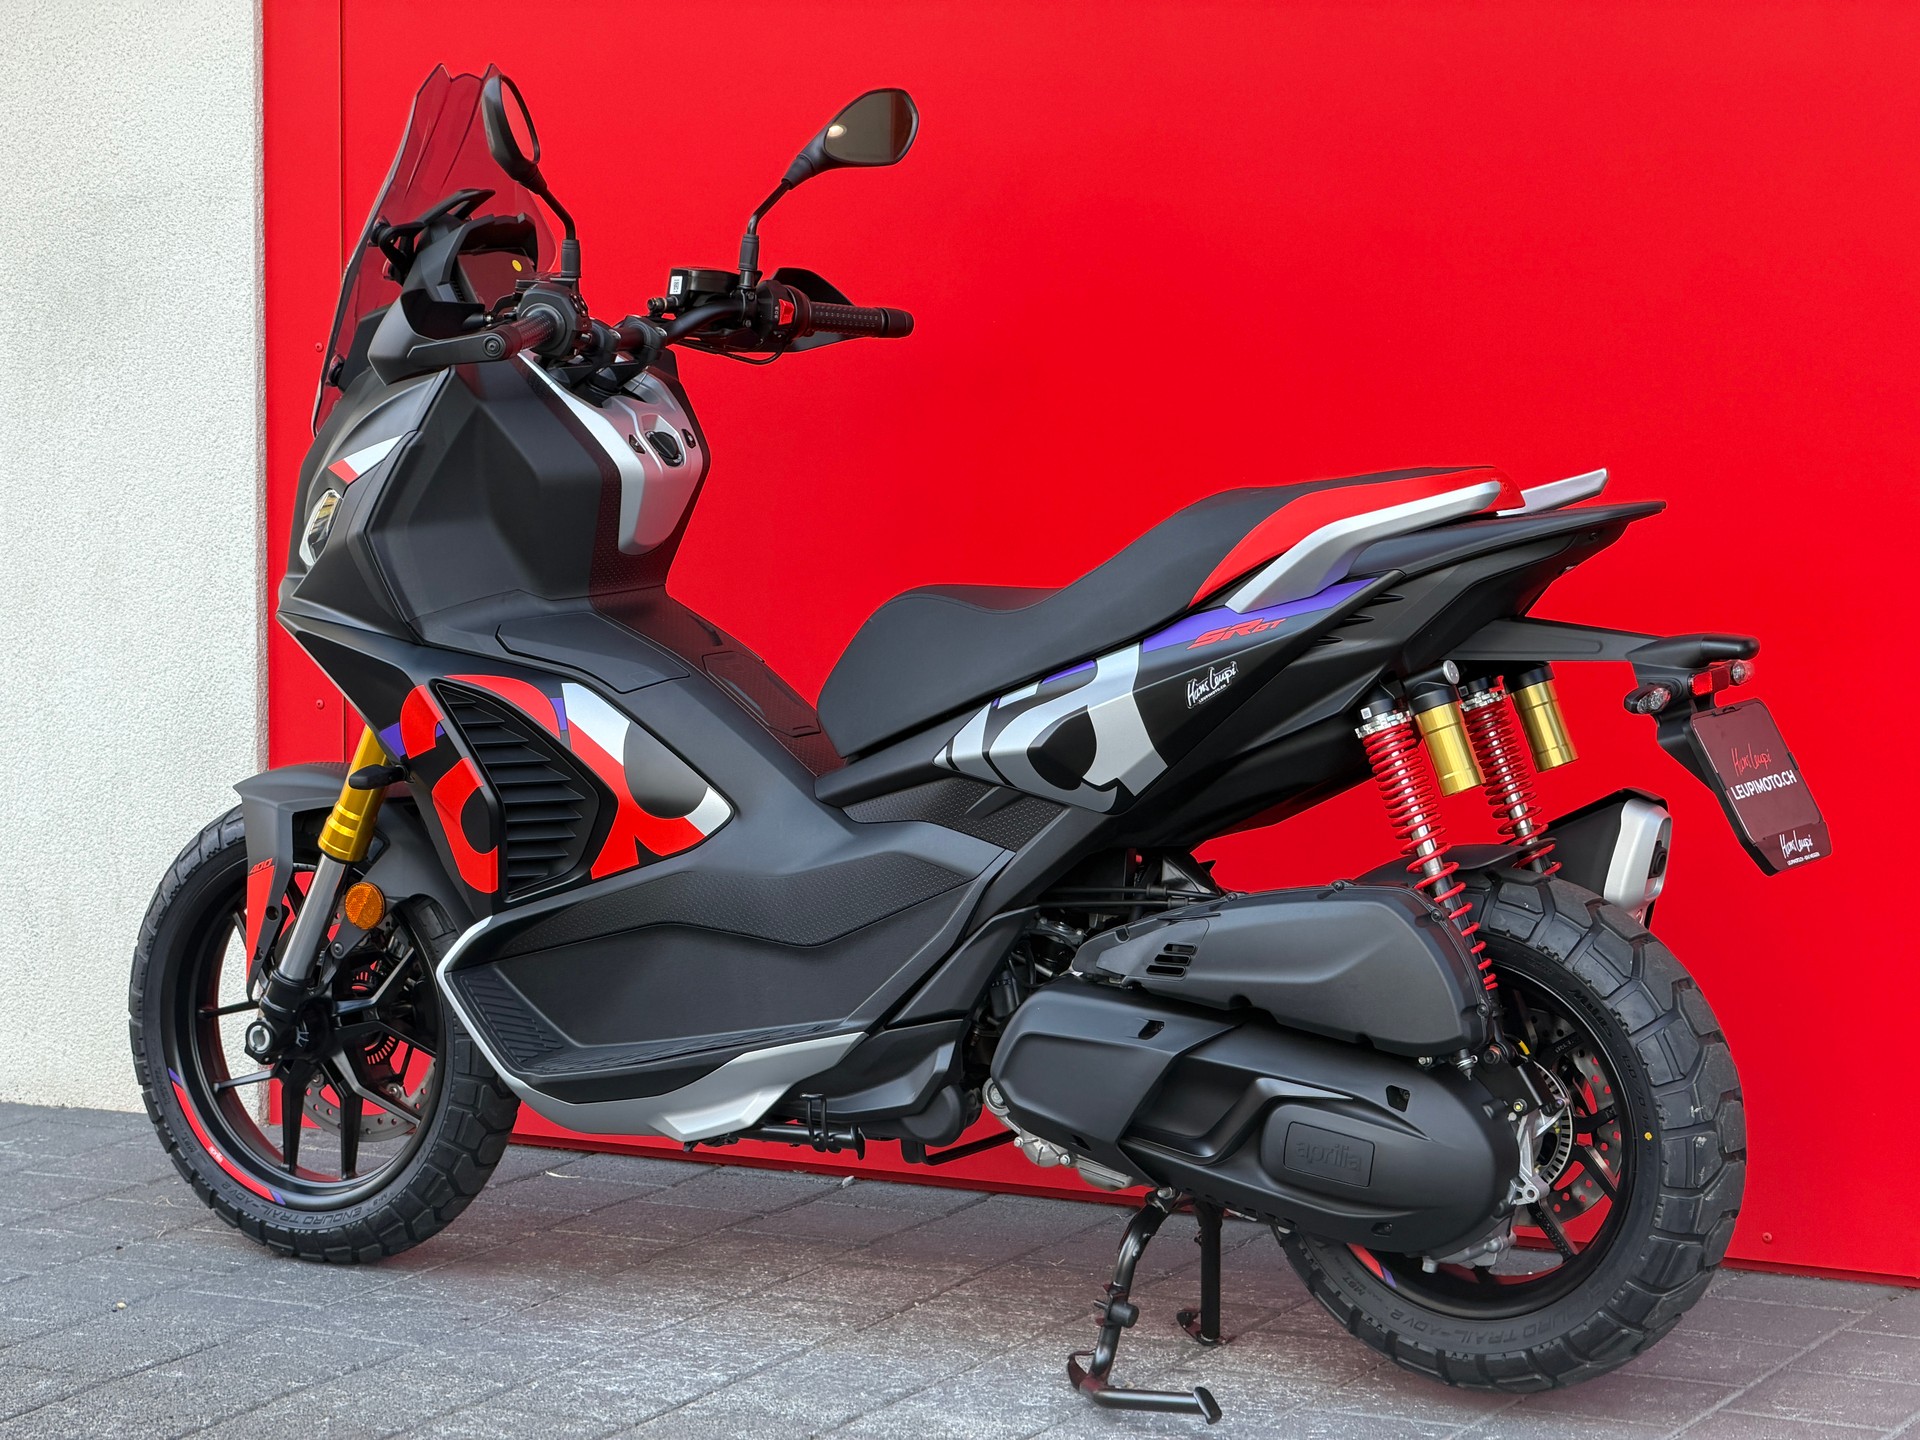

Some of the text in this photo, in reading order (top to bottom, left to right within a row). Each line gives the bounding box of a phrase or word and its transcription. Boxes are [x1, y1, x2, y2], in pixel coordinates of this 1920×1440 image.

[1730, 769, 1797, 801] LEUPIMOTO.CH
[1296, 1142, 1363, 1172] aprilia
[302, 1206, 362, 1225] ENDURO
